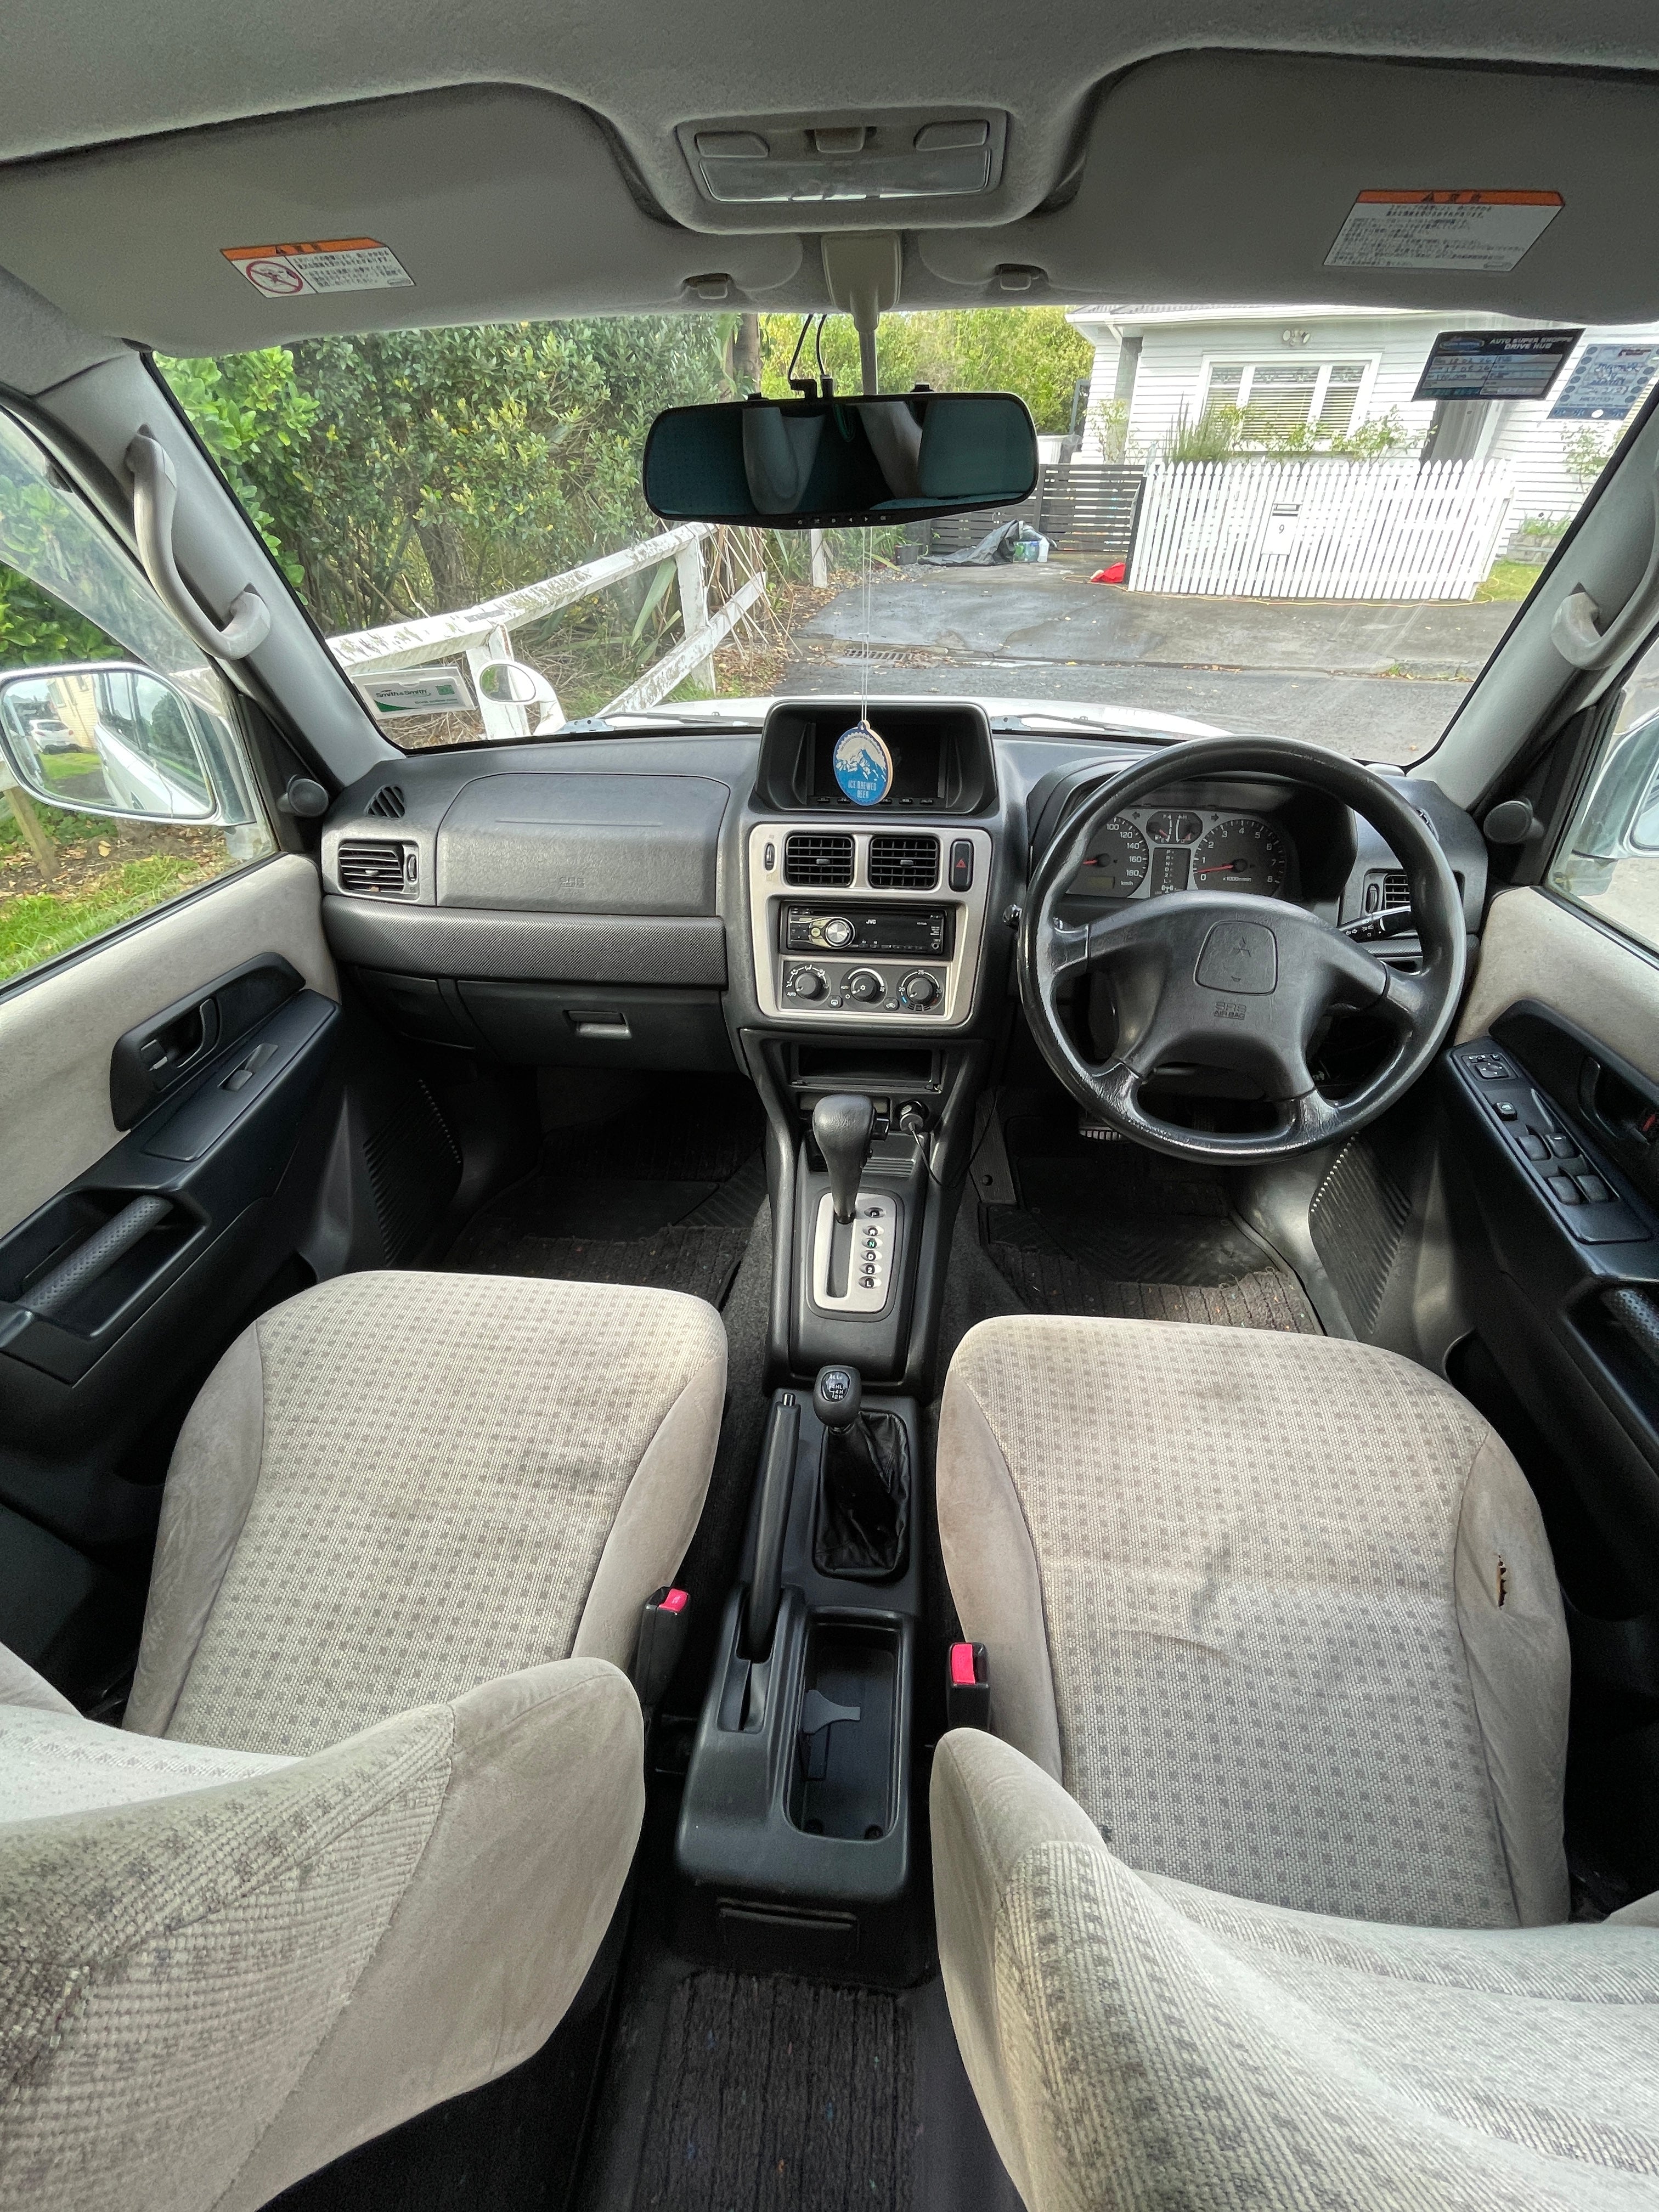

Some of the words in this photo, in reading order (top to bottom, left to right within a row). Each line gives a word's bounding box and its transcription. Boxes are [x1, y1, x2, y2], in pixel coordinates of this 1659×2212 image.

[1279, 524, 1285, 534] 9
[857, 781, 877, 791] BREWED
[857, 789, 869, 799] BEER
